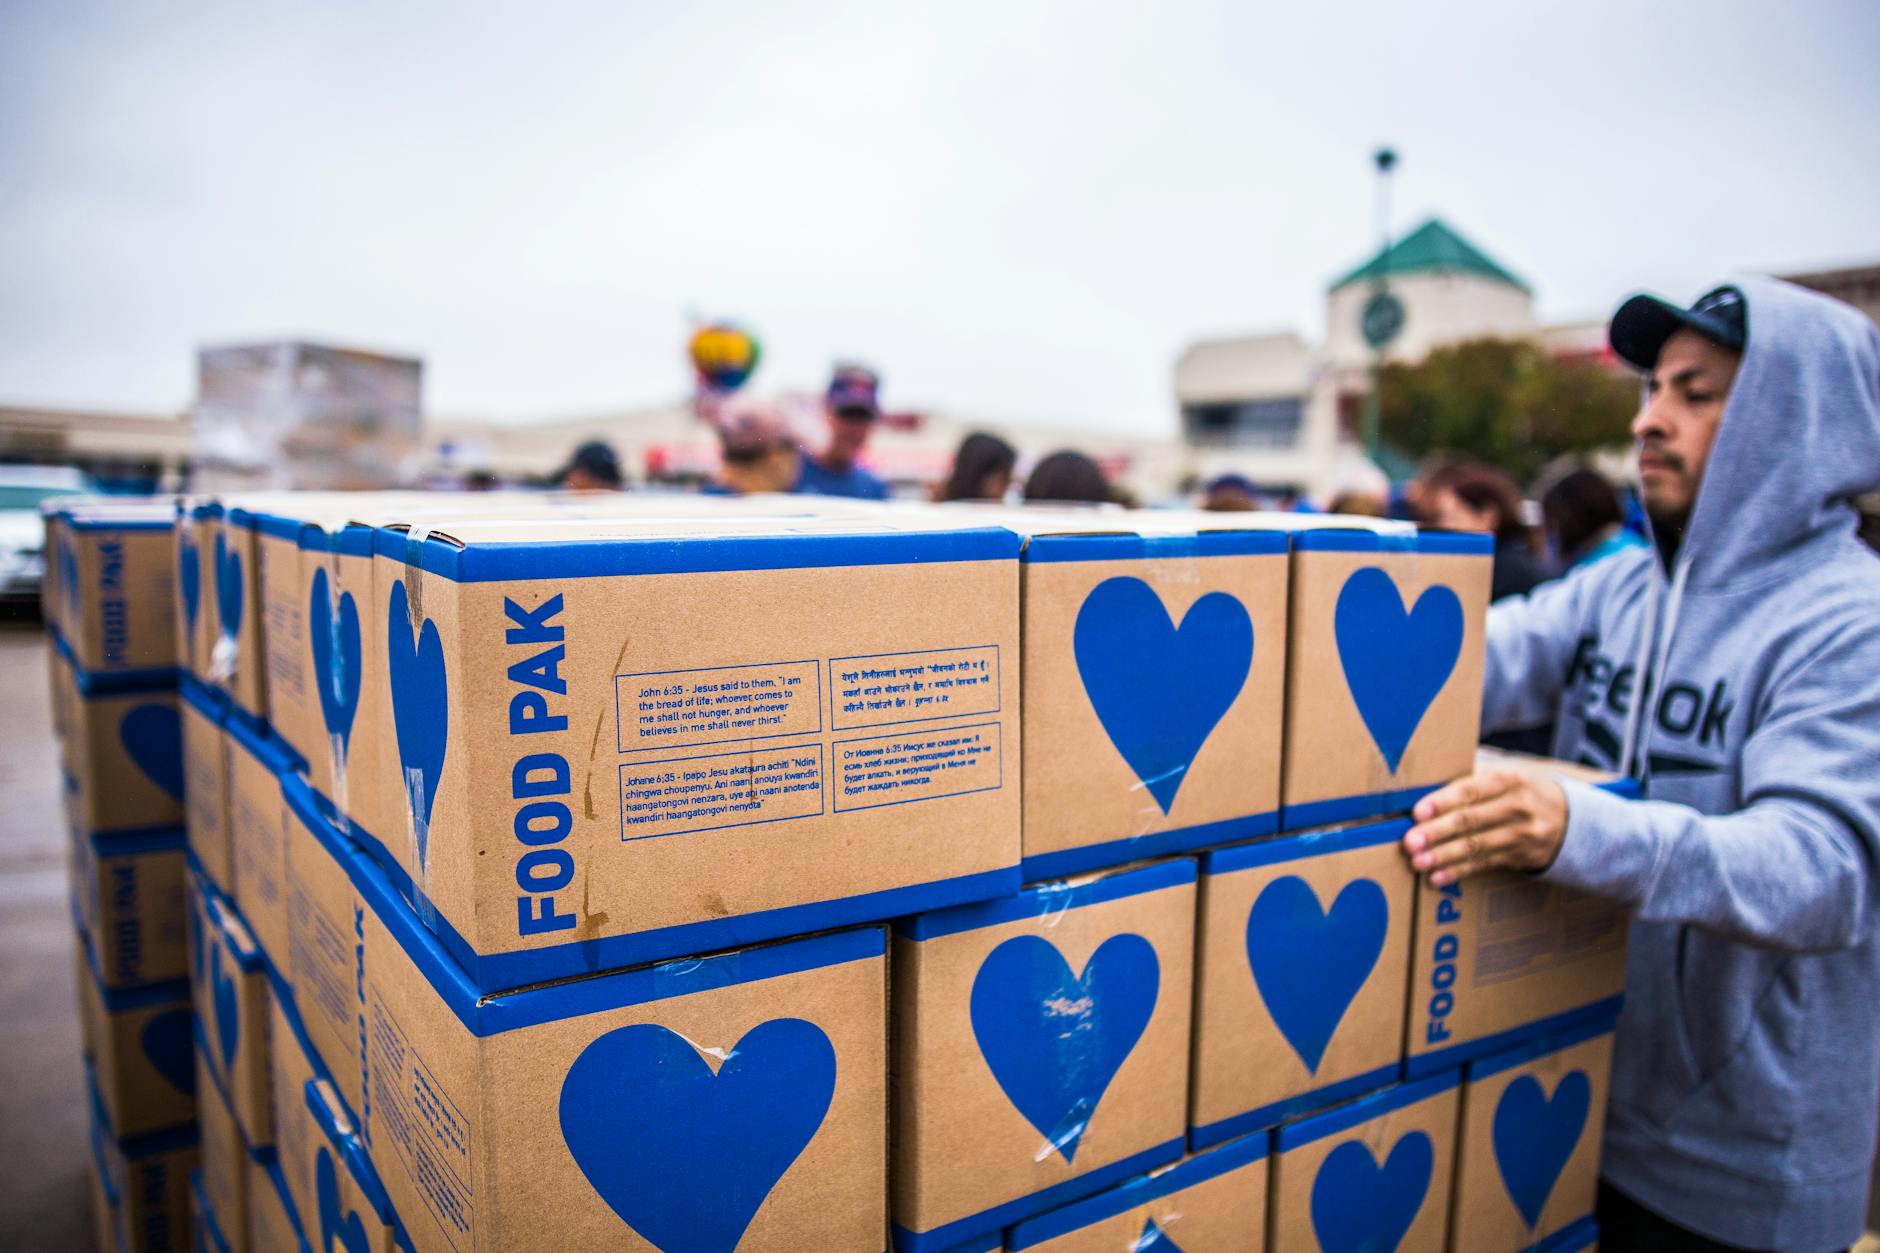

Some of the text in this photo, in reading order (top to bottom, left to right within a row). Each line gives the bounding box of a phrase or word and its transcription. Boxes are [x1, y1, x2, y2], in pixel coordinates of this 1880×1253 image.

[639, 688, 661, 698] John
[664, 685, 683, 696] 6:35
[692, 684, 718, 693] Jesus
[720, 681, 738, 691] said
[741, 681, 750, 689] to
[639, 690, 793, 711] the bread of life; whoever comes to
[640, 716, 654, 724] me
[657, 712, 679, 722] shall
[682, 711, 696, 720] not
[735, 705, 751, 715] and
[753, 704, 789, 713] whoever
[640, 726, 678, 737] believes
[680, 724, 688, 733] in
[691, 724, 705, 732] me
[708, 720, 729, 730] shall
[732, 719, 755, 727] never
[844, 751, 854, 759] От
[886, 744, 901, 754] 6:35
[503, 592, 576, 935] FOOD PAK
[864, 759, 882, 768] хлеб
[626, 777, 655, 787] Johane
[656, 773, 675, 783] 6:35
[683, 771, 706, 782] Ipapo
[708, 769, 728, 778] Jesu
[730, 764, 766, 775] akataura
[626, 790, 663, 799] chingwa
[715, 780, 728, 789] Ani
[730, 777, 753, 787] naani
[754, 775, 783, 784] anouya
[785, 769, 818, 781] kwandiri
[845, 774, 865, 784] будет
[626, 797, 689, 812] haangatongovi
[729, 792, 744, 801] uye
[745, 788, 758, 799] ani
[760, 787, 781, 795] naani
[783, 781, 820, 793] anotenda
[845, 786, 866, 796] будет
[627, 812, 664, 824] kwandiri
[666, 806, 727, 820] haangatongovi
[1426, 879, 1462, 1044] FOOD PA
